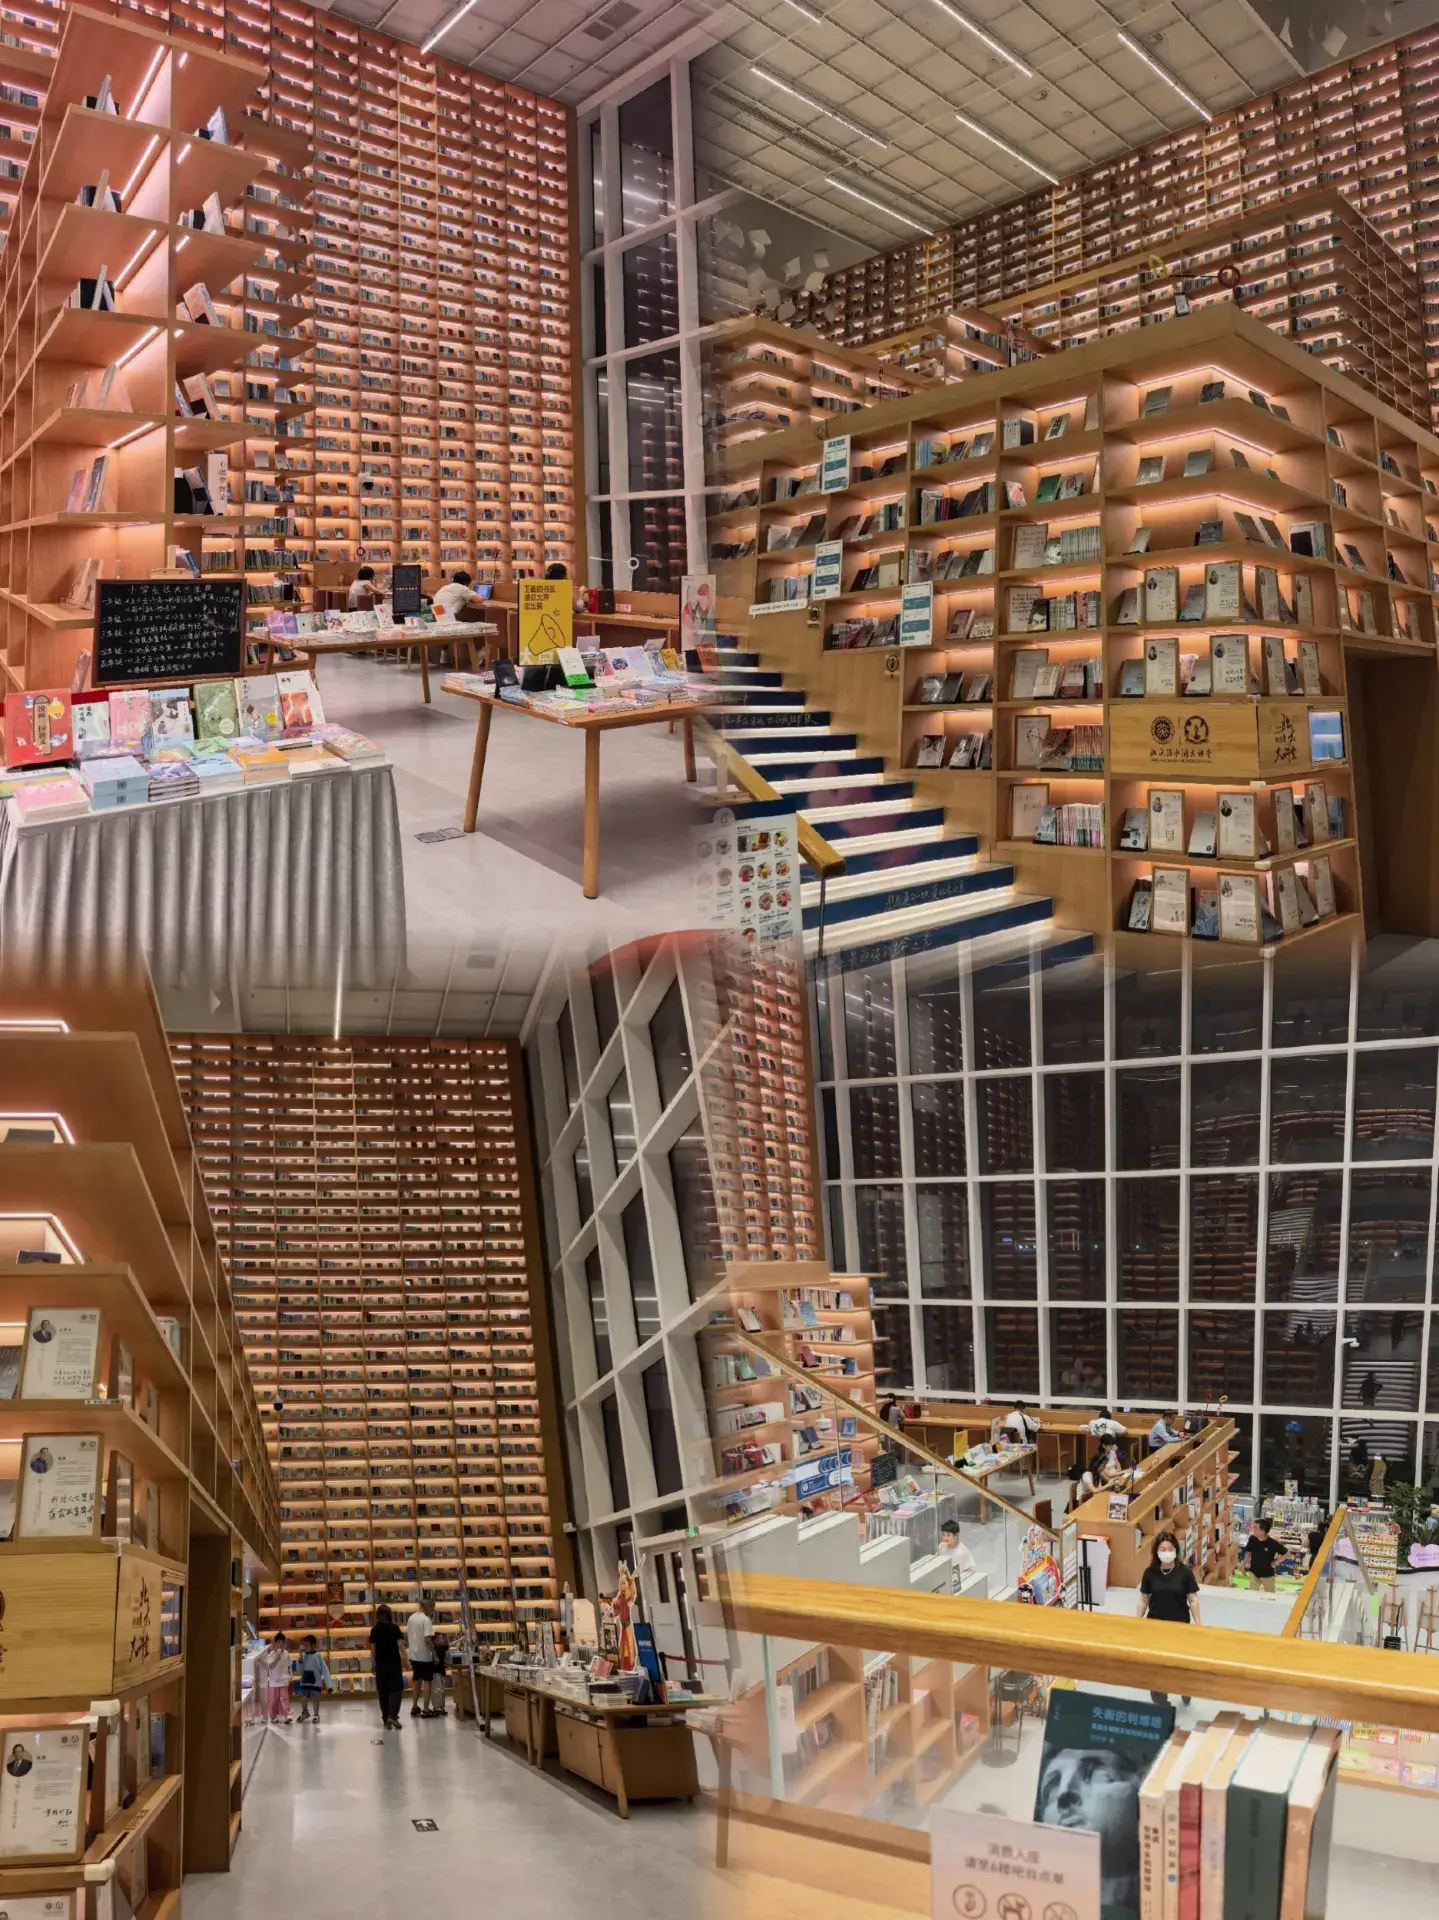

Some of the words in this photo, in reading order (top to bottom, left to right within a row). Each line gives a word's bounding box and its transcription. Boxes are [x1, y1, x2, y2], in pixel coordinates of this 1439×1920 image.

[1092, 1706, 1162, 1729] 失衡的利维坦
